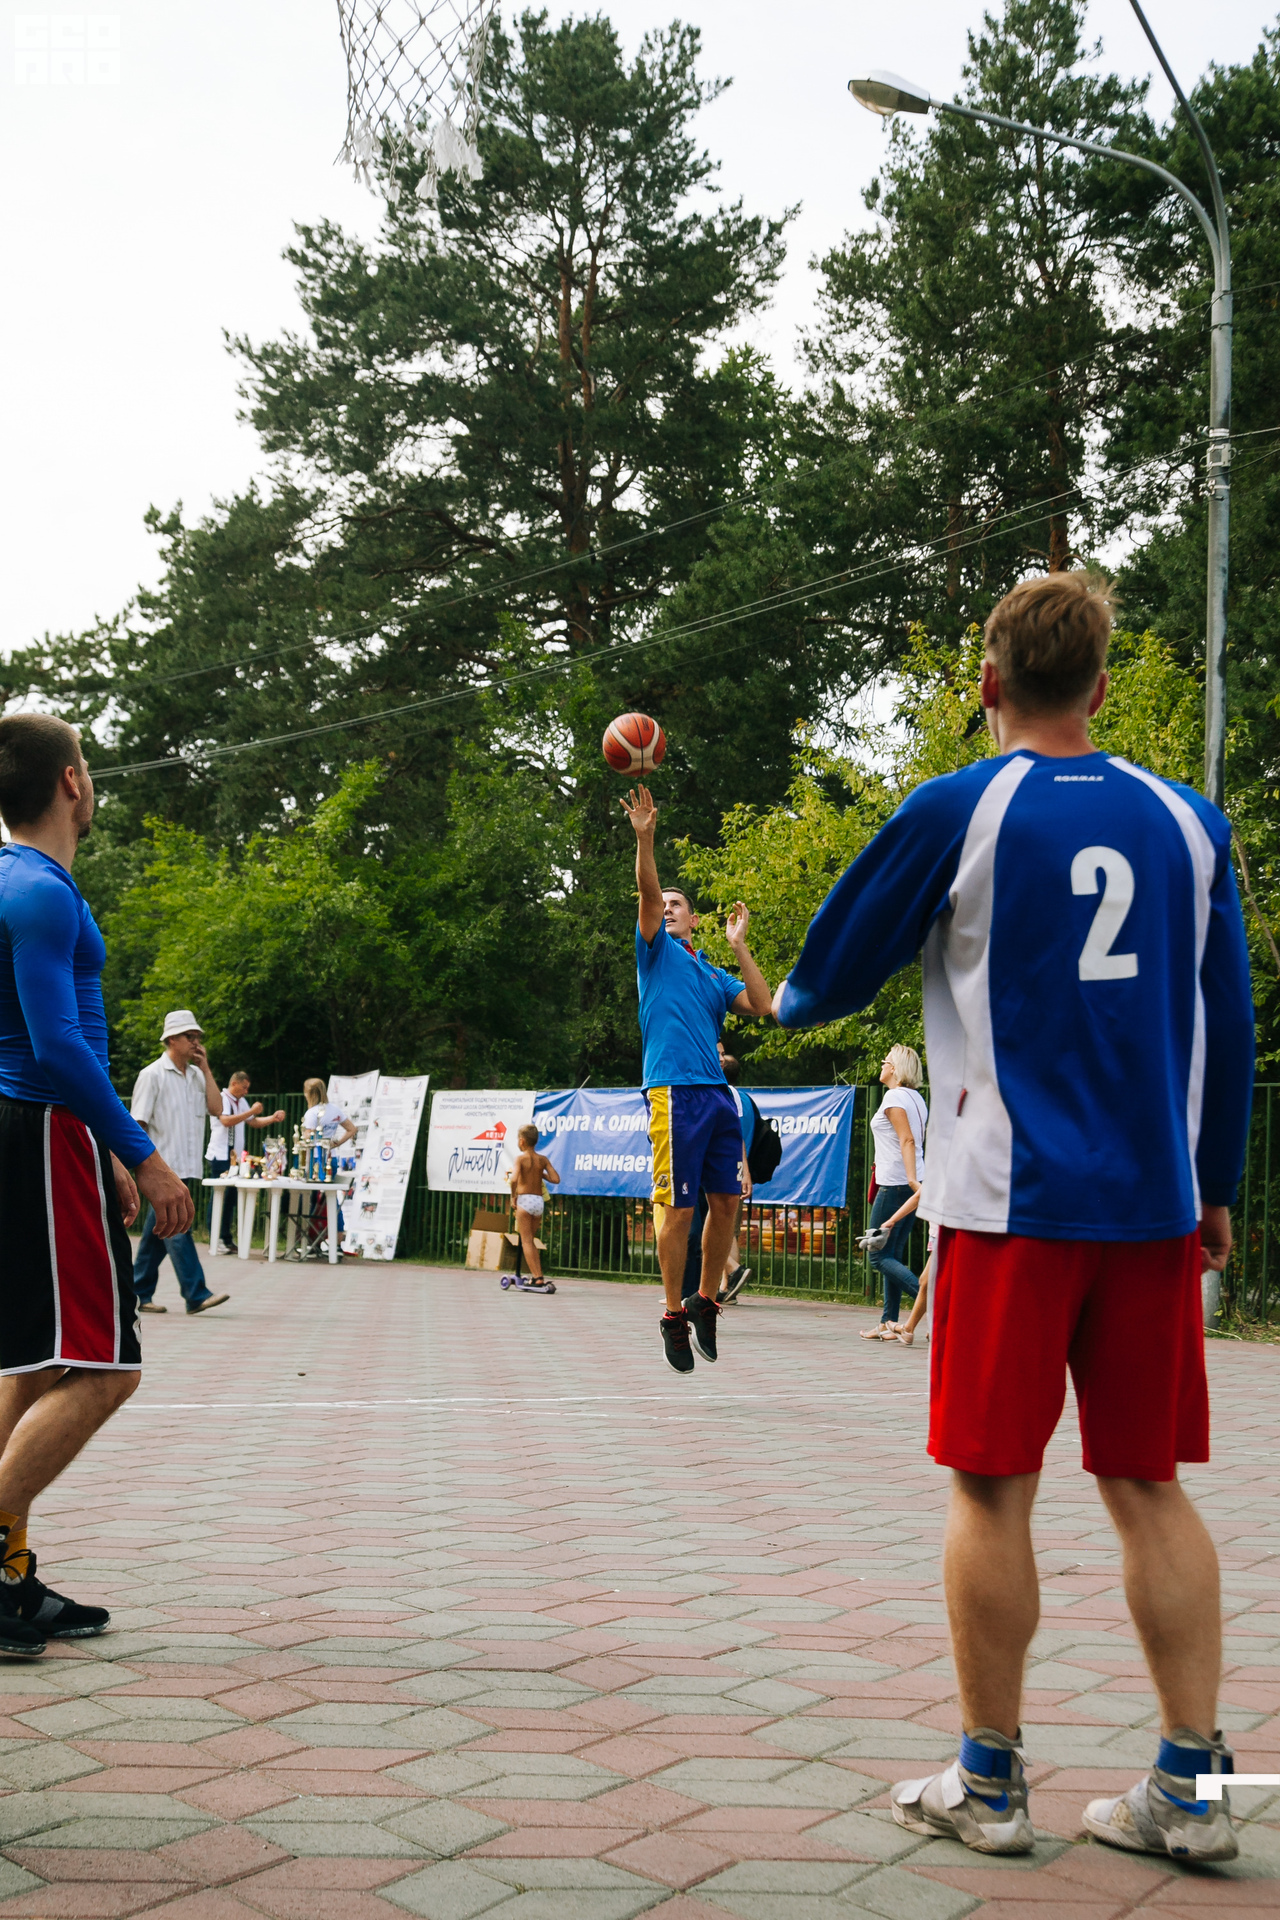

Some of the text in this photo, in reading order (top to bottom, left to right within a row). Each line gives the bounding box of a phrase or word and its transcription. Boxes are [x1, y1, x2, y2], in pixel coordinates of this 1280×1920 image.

[1071, 846, 1138, 981] 2
[534, 1111, 591, 1137] Дорога
[593, 1115, 606, 1131] к
